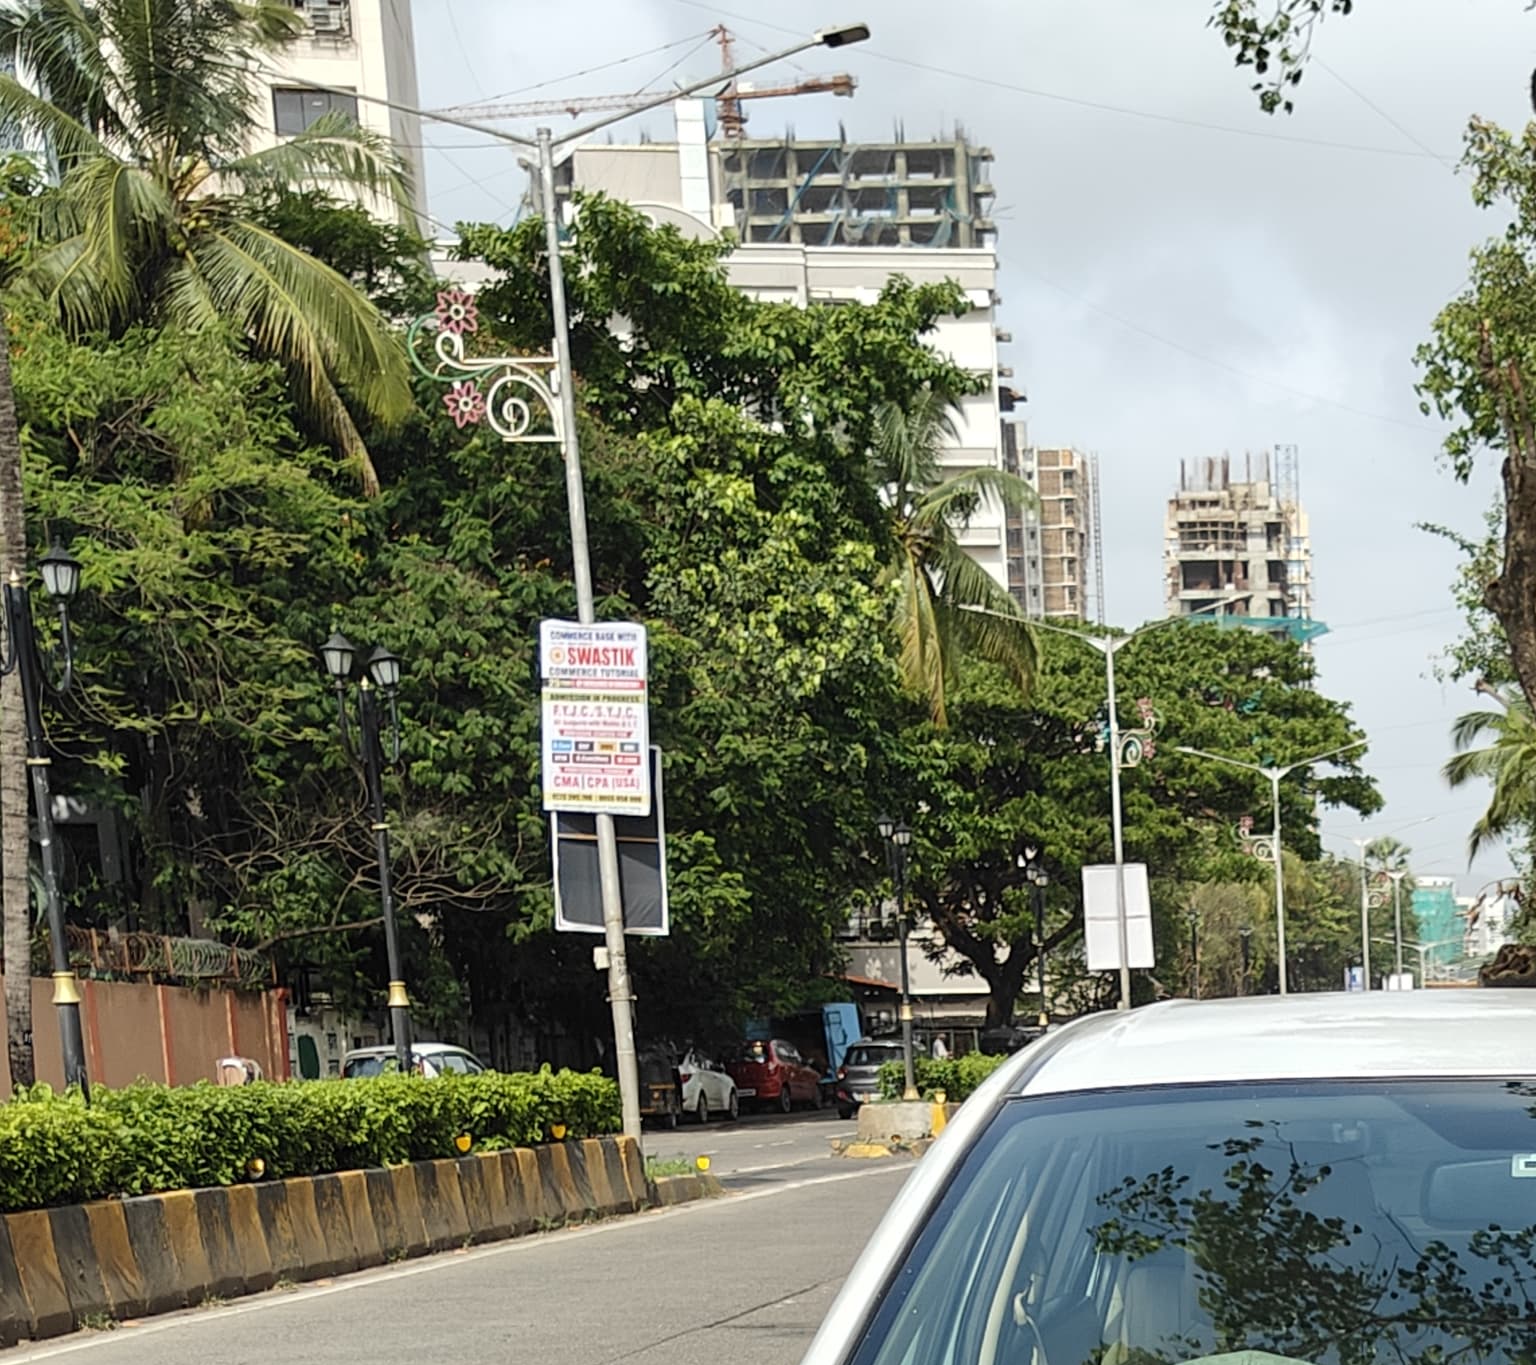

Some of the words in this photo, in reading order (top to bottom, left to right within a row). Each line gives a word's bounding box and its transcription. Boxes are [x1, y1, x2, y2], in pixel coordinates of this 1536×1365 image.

[550, 631, 593, 640] COMMERCE
[567, 647, 635, 666] SWASTIK
[549, 667, 597, 677] COMMERCE
[600, 668, 638, 678] TUTORIAL
[553, 776, 579, 787] CMA
[587, 777, 609, 788] CPA
